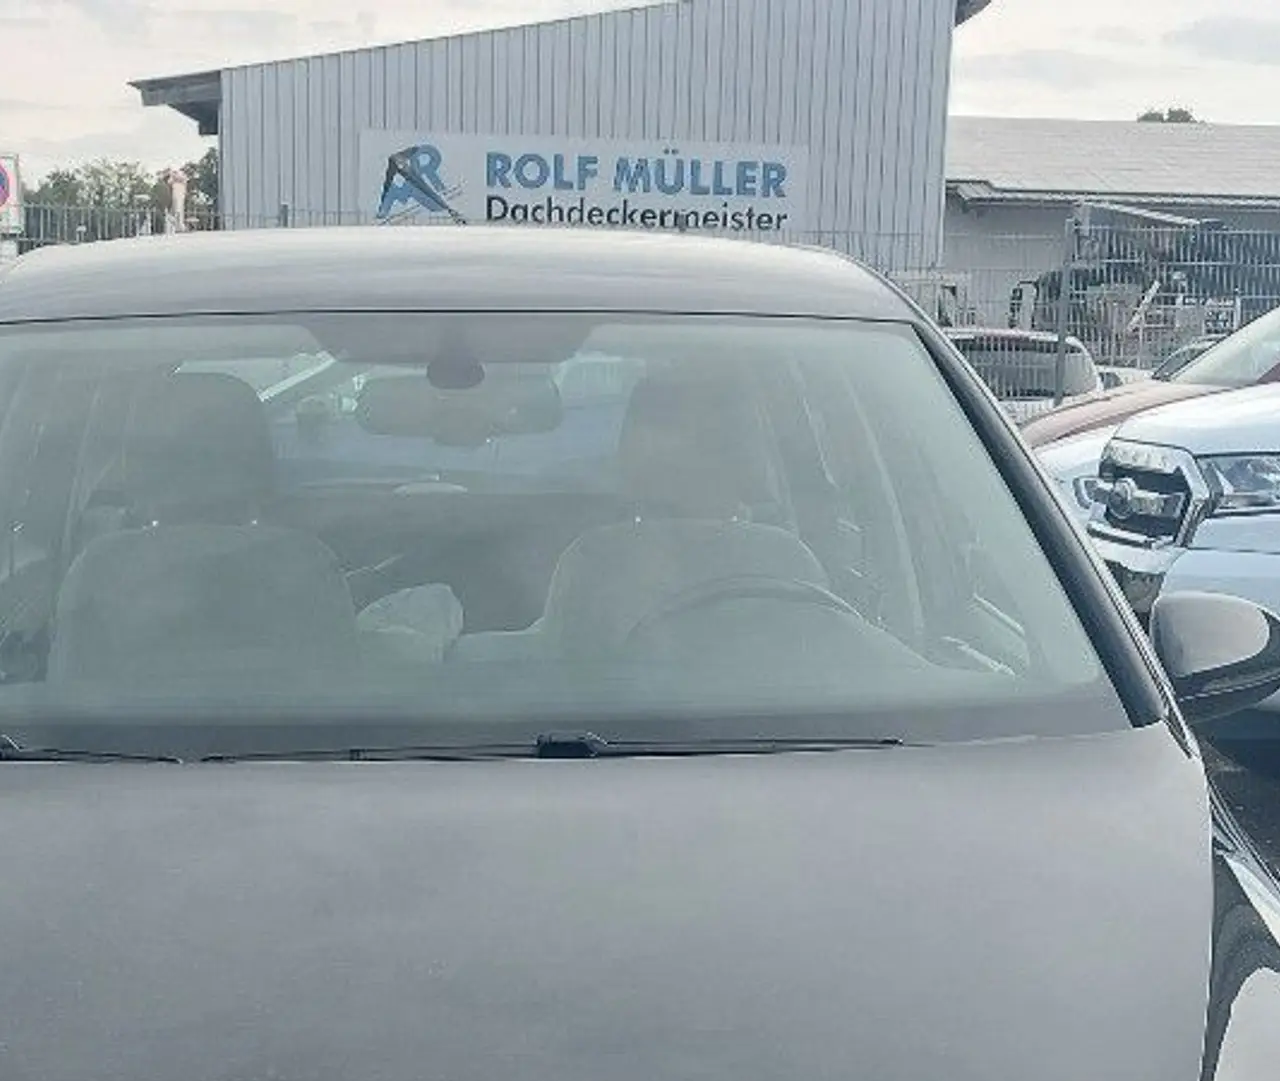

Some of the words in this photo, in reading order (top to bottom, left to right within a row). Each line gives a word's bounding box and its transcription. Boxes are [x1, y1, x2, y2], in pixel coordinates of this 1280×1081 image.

[485, 151, 598, 191] ROLF
[613, 149, 787, 198] MÜLLER
[485, 195, 788, 231] Dachdeckermeister
